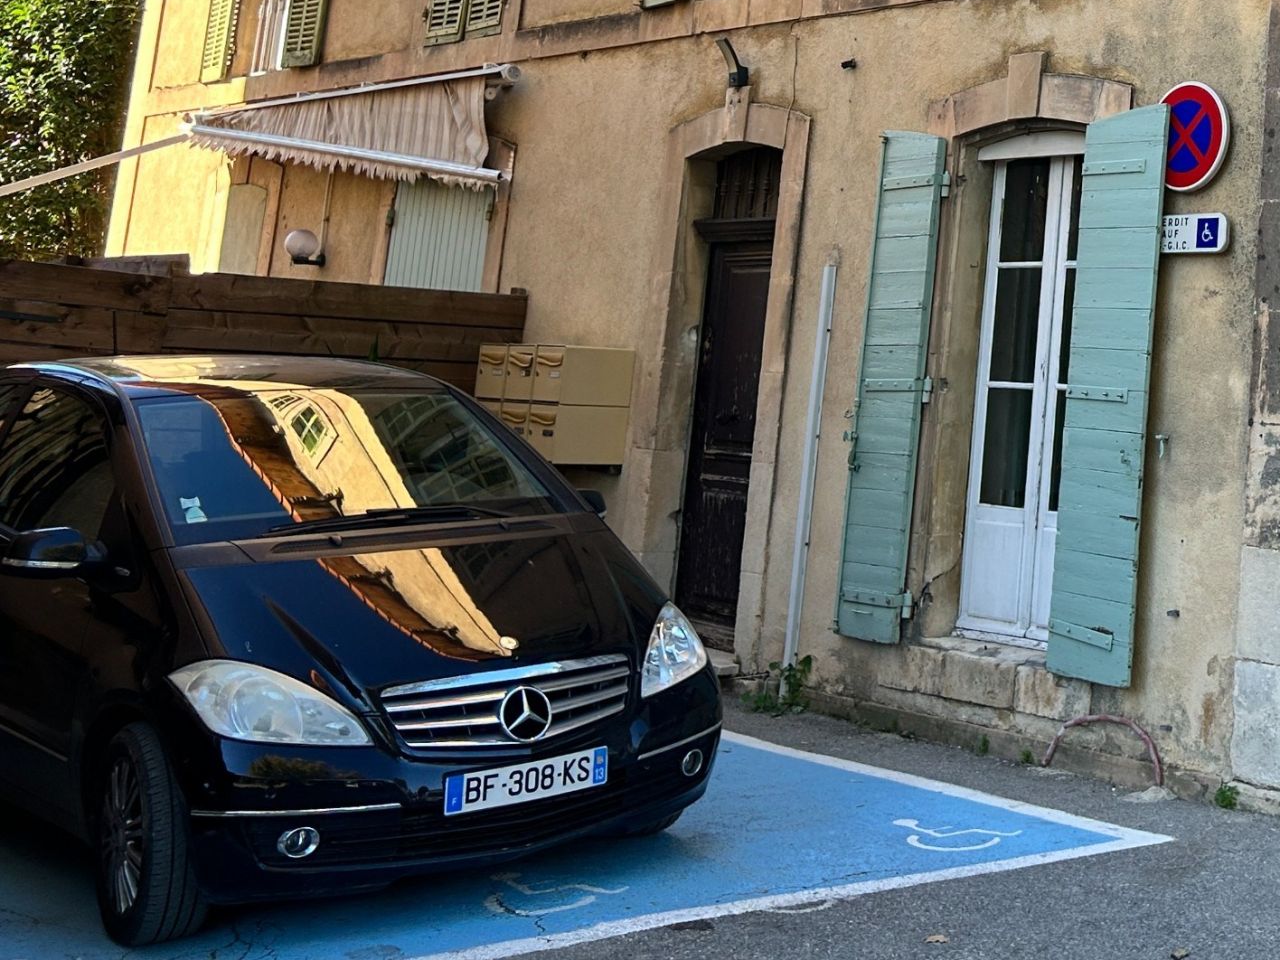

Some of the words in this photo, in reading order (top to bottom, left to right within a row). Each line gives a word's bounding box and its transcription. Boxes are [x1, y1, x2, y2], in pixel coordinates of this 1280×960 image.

[1162, 217, 1188, 227] ERDIT
[1162, 229, 1179, 239] AUF
[595, 767, 604, 781] 13
[465, 756, 590, 804] BF-308-KS
[451, 797, 458, 807] F
